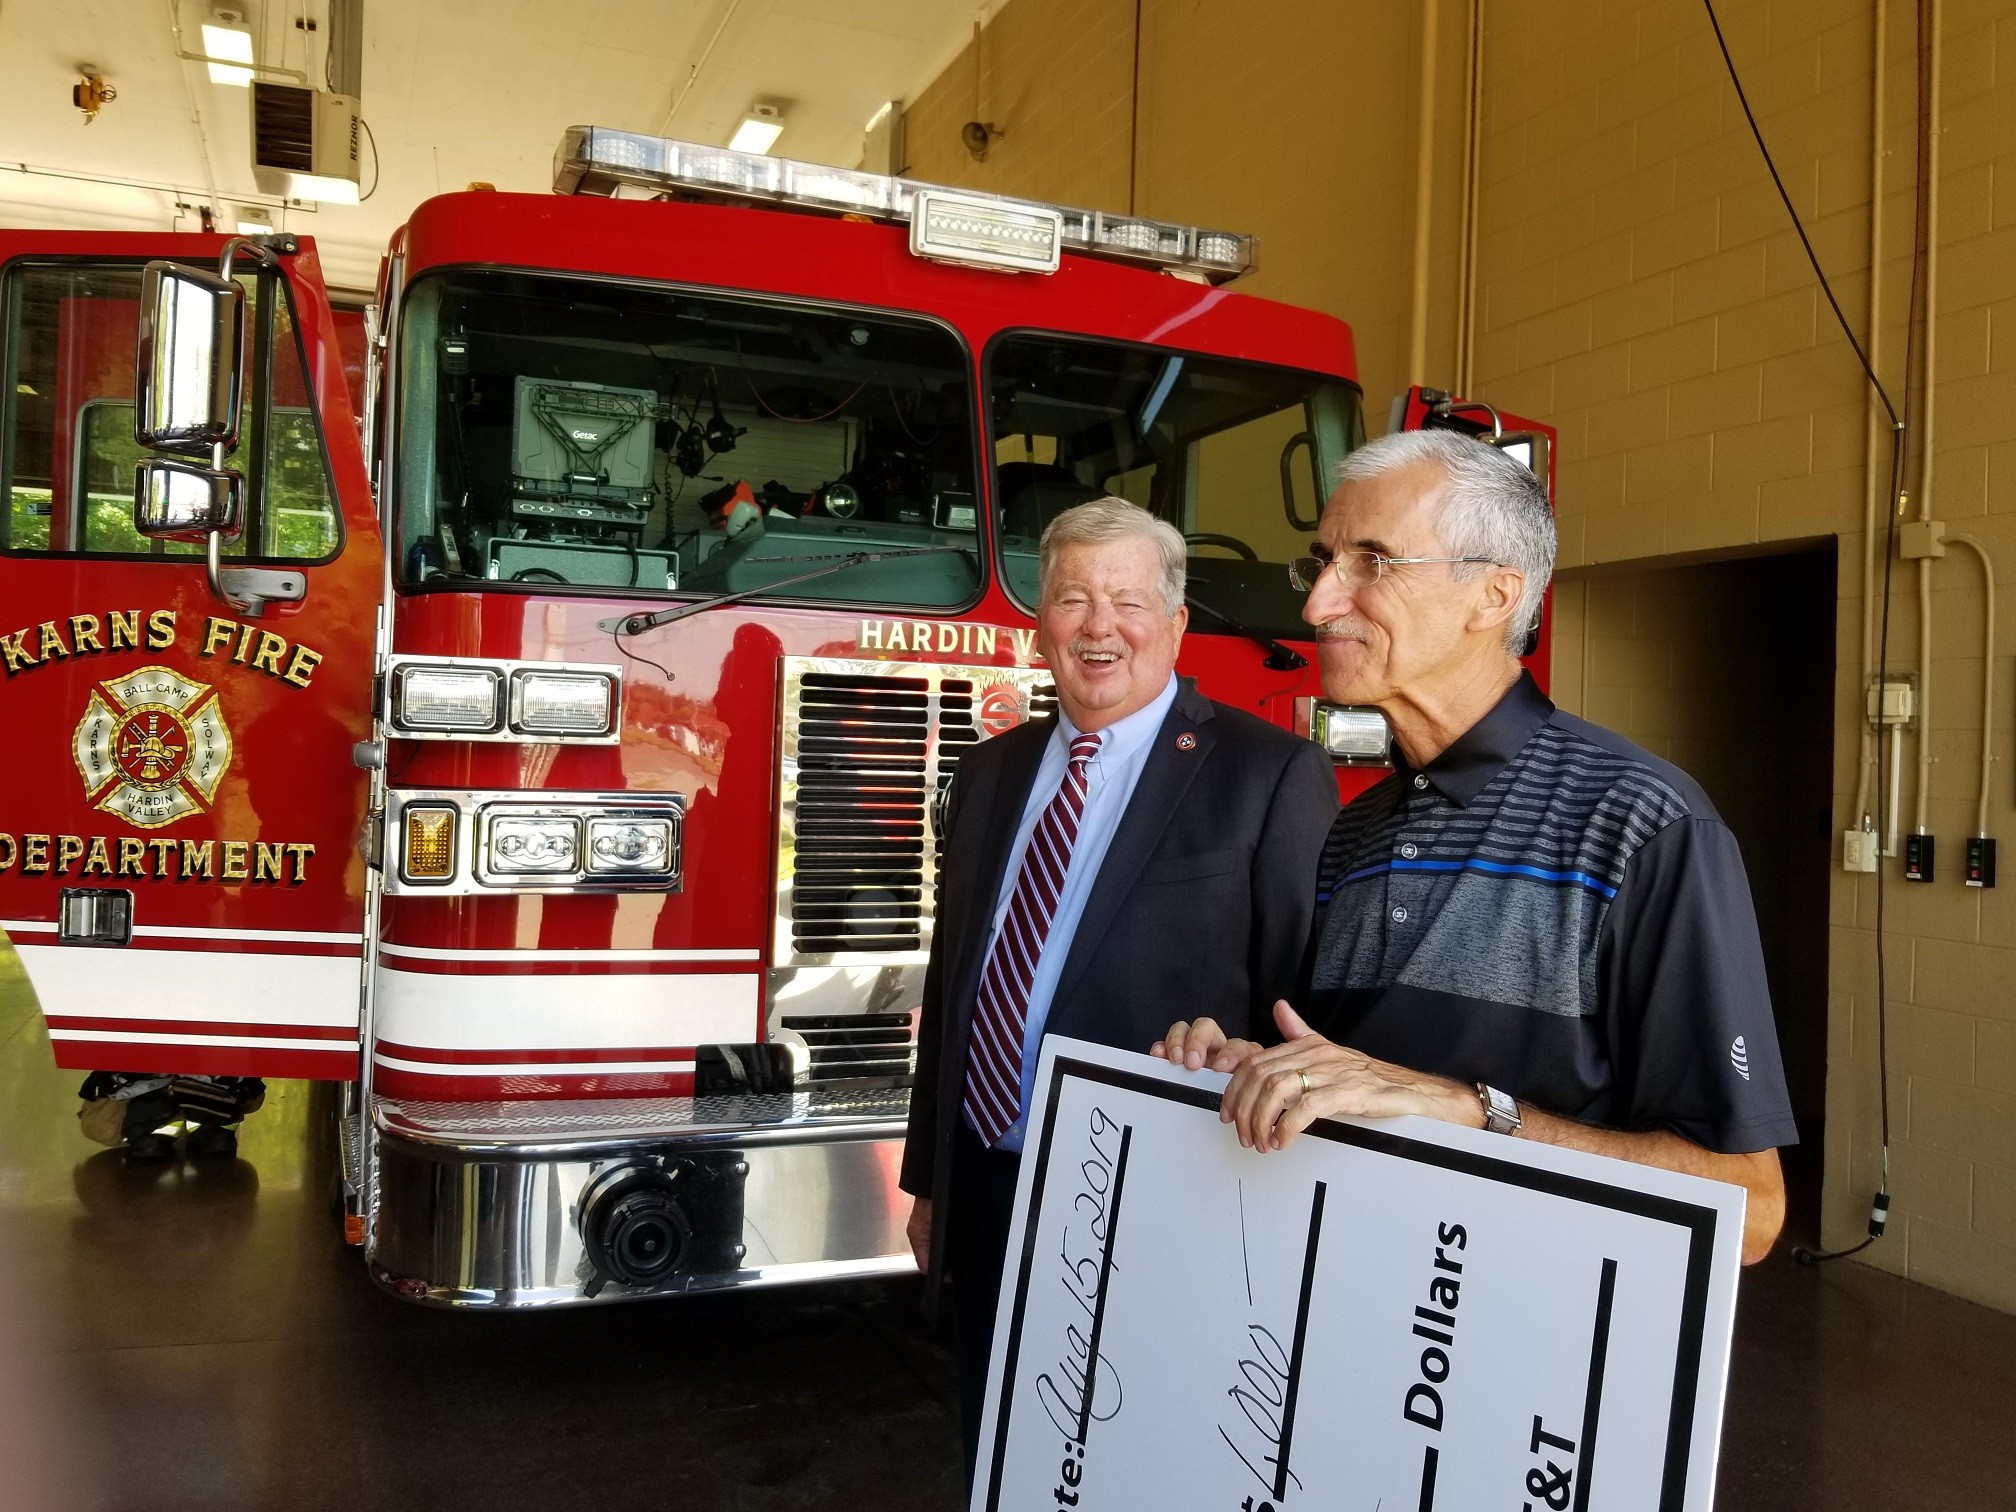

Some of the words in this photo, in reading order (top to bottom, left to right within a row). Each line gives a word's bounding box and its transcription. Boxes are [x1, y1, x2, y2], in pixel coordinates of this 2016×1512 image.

[350, 114, 358, 161] REZNOR
[572, 430, 598, 441] Getac
[0, 609, 177, 672] KARNS
[200, 616, 323, 688] FIRE
[860, 619, 998, 655] HARDIN
[1015, 628, 1044, 658] V
[123, 683, 151, 699] BALL
[156, 683, 189, 700] CAMP
[90, 718, 102, 771] KARNS
[201, 717, 215, 780] SOLWAY
[127, 792, 174, 806] HARDIN
[128, 805, 172, 817] VALLEY
[0, 832, 316, 881] DEPARTMENT
[1074, 1106, 1123, 1242] 2019
[1403, 1220, 1468, 1433] Dollars
[1036, 1323, 1123, 1442] Aug
[1053, 1441, 1085, 1512] te:
